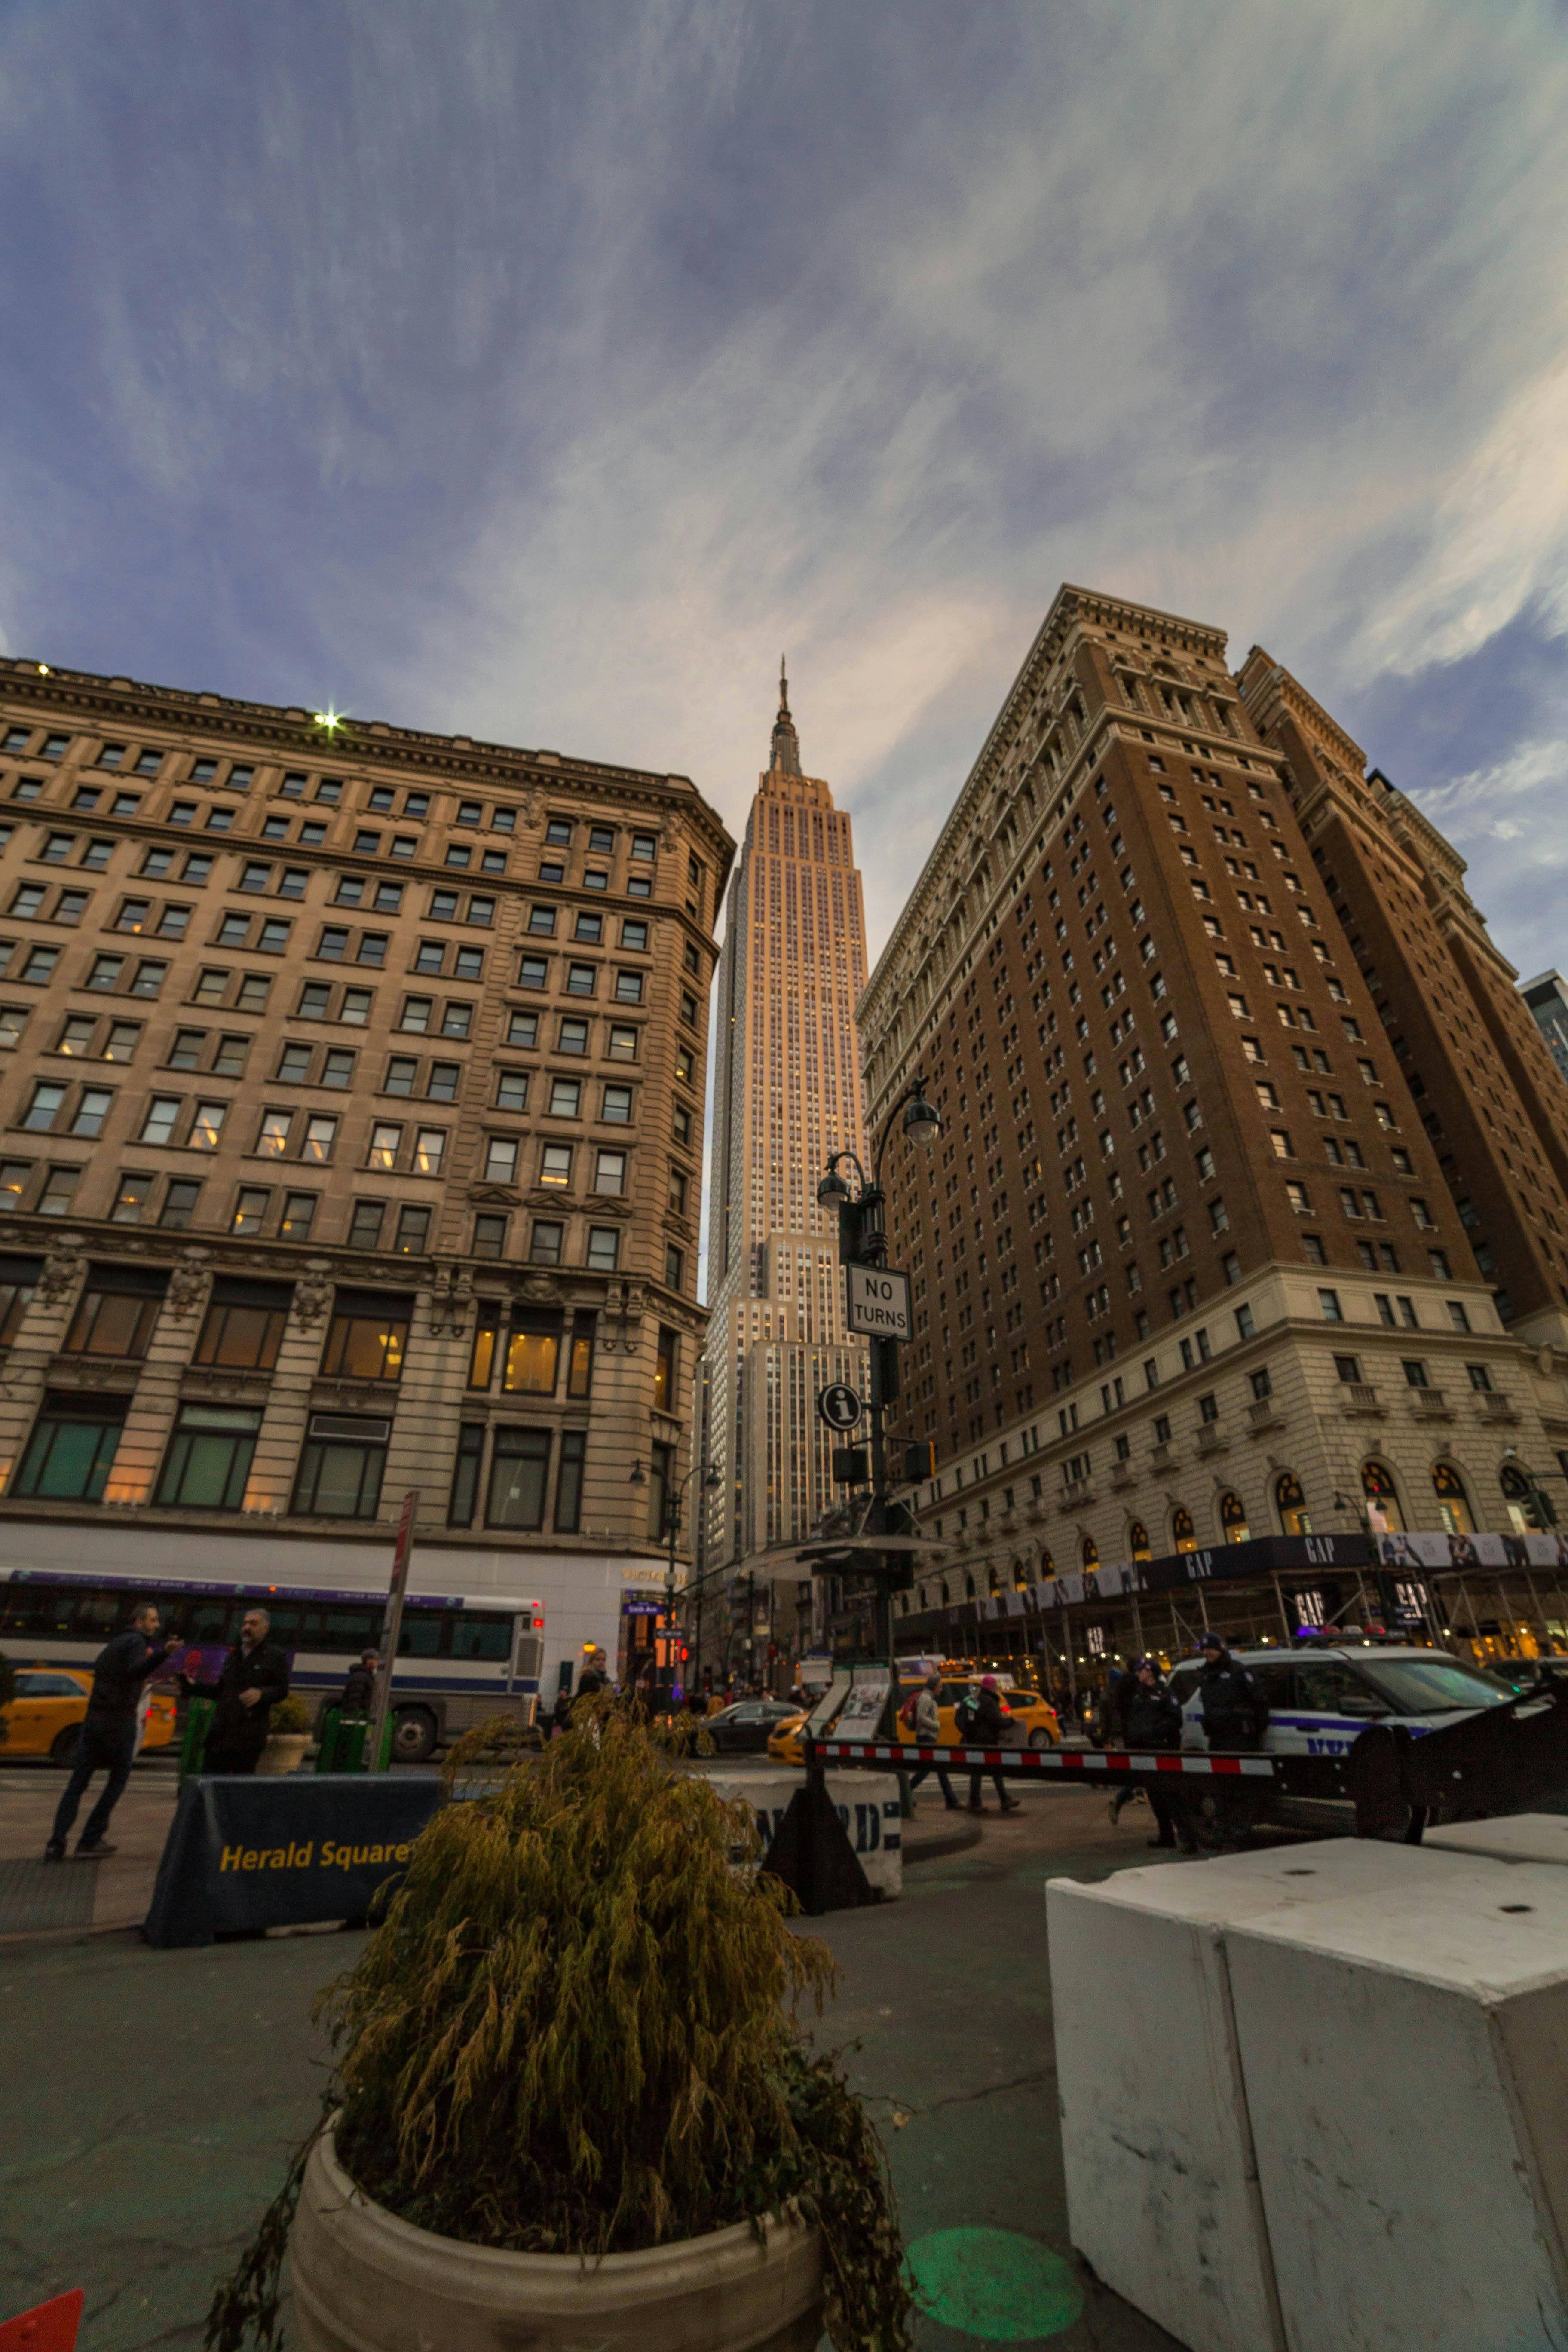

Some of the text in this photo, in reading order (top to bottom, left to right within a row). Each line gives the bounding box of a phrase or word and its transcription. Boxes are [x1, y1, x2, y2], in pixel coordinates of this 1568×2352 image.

[865, 1277, 893, 1301] NO
[854, 1303, 906, 1329] TURNS
[1305, 1537, 1335, 1564] GAP
[1185, 1550, 1213, 1580] GAP
[1295, 1590, 1325, 1627] GAP
[220, 1841, 410, 1872] Herald Square
